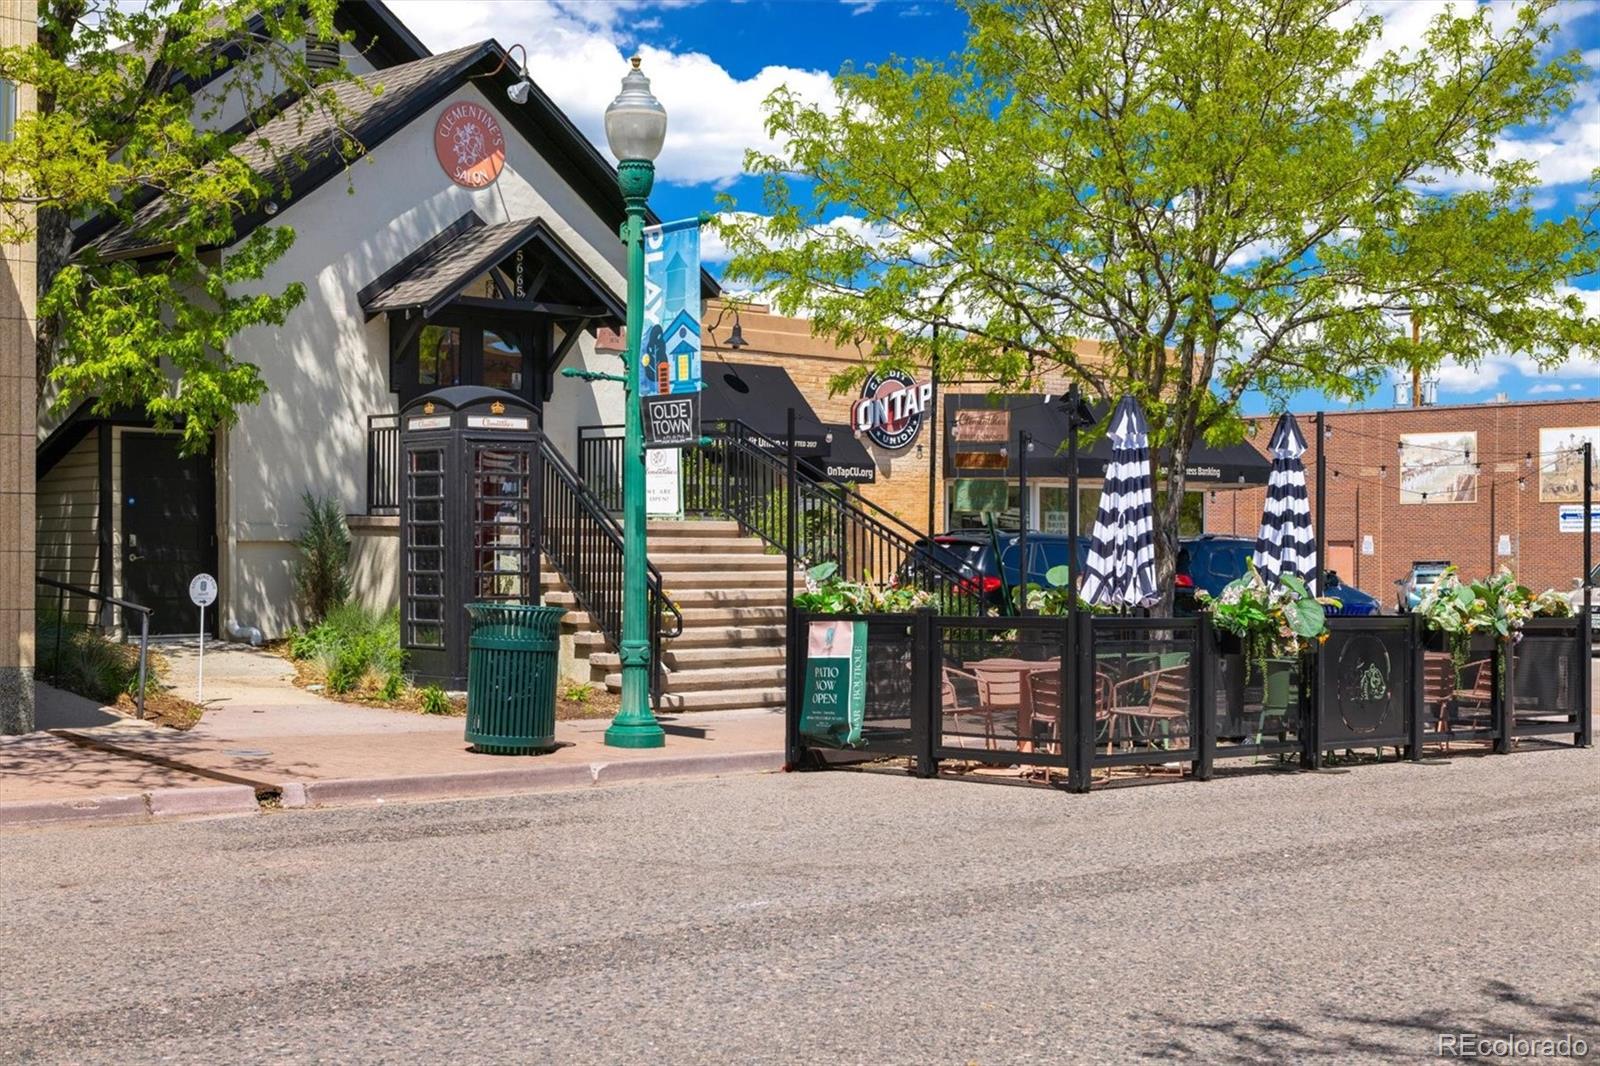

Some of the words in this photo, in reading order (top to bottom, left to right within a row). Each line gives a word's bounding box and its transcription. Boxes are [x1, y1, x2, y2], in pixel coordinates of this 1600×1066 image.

[439, 105, 503, 146] CLEMENTINE'S
[453, 165, 490, 187] SALON
[515, 249, 525, 298] 5665
[653, 402, 688, 420] OLDE
[653, 418, 691, 435] TOWN
[882, 425, 915, 445] UNION
[826, 465, 874, 480] OnTapCU.org
[1197, 466, 1221, 478] Banking
[814, 666, 840, 678] PATIO
[853, 644, 863, 700] BOUTIQUE
[815, 680, 836, 691] NOW
[811, 692, 838, 705] OPEN!
